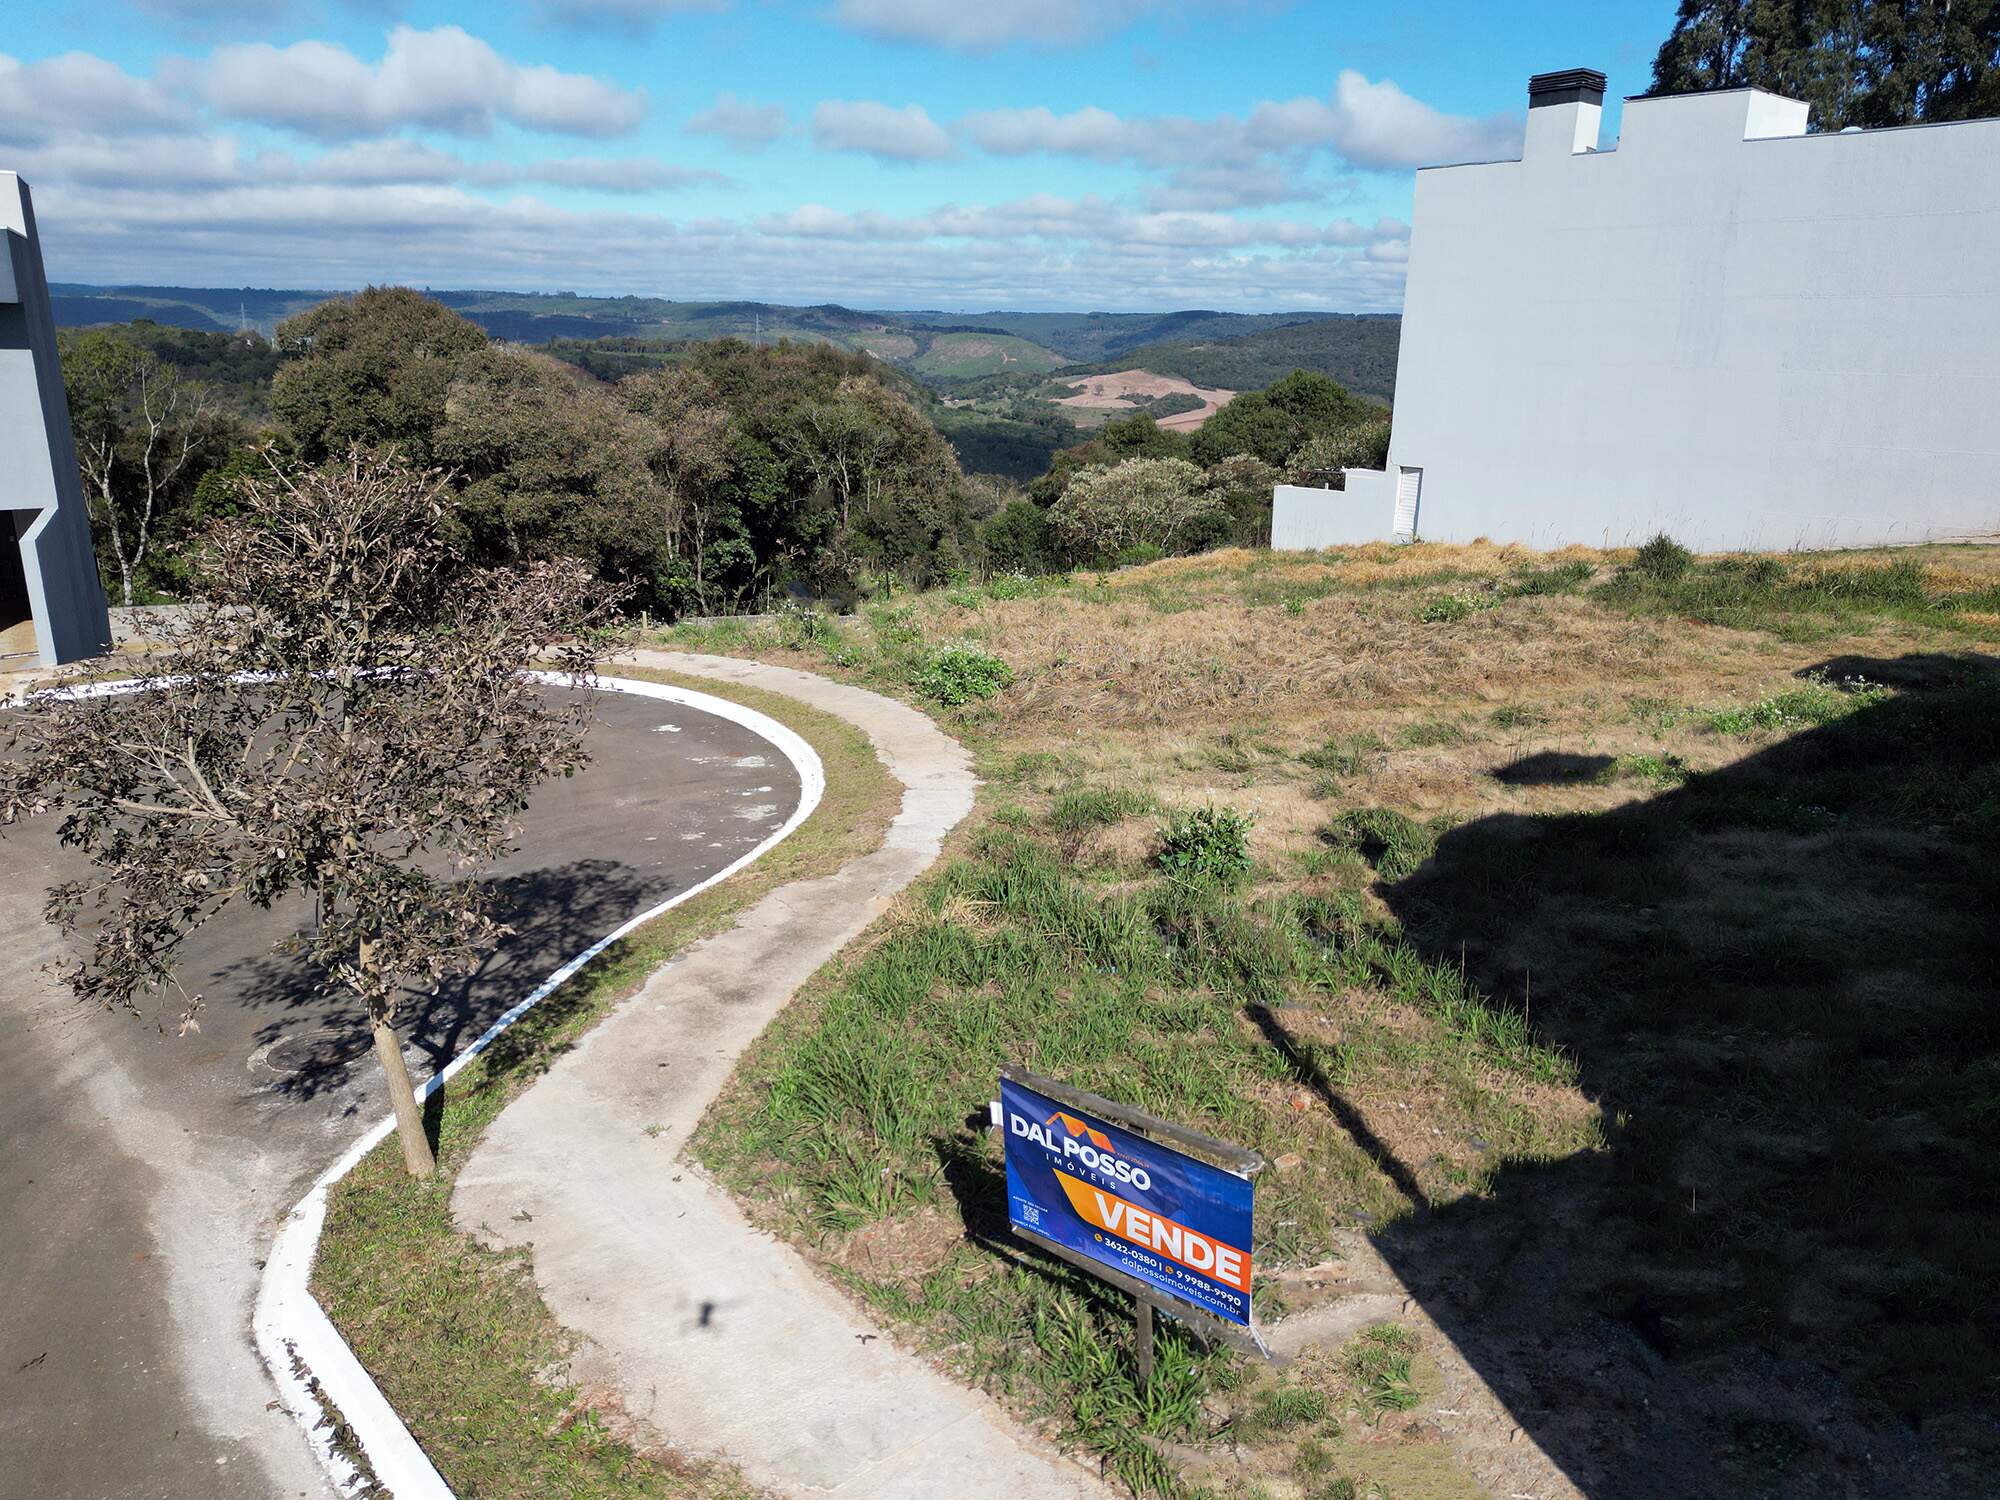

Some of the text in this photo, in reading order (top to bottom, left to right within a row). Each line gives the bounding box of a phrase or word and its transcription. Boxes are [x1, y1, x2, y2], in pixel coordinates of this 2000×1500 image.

[1046, 1153, 1116, 1190] IMÓVEIS
[1095, 1191, 1241, 1286] VENDE
[1104, 1238, 1157, 1267] 3622-0380
[1121, 1256, 1241, 1316] dalpossoimoveis.com.br
